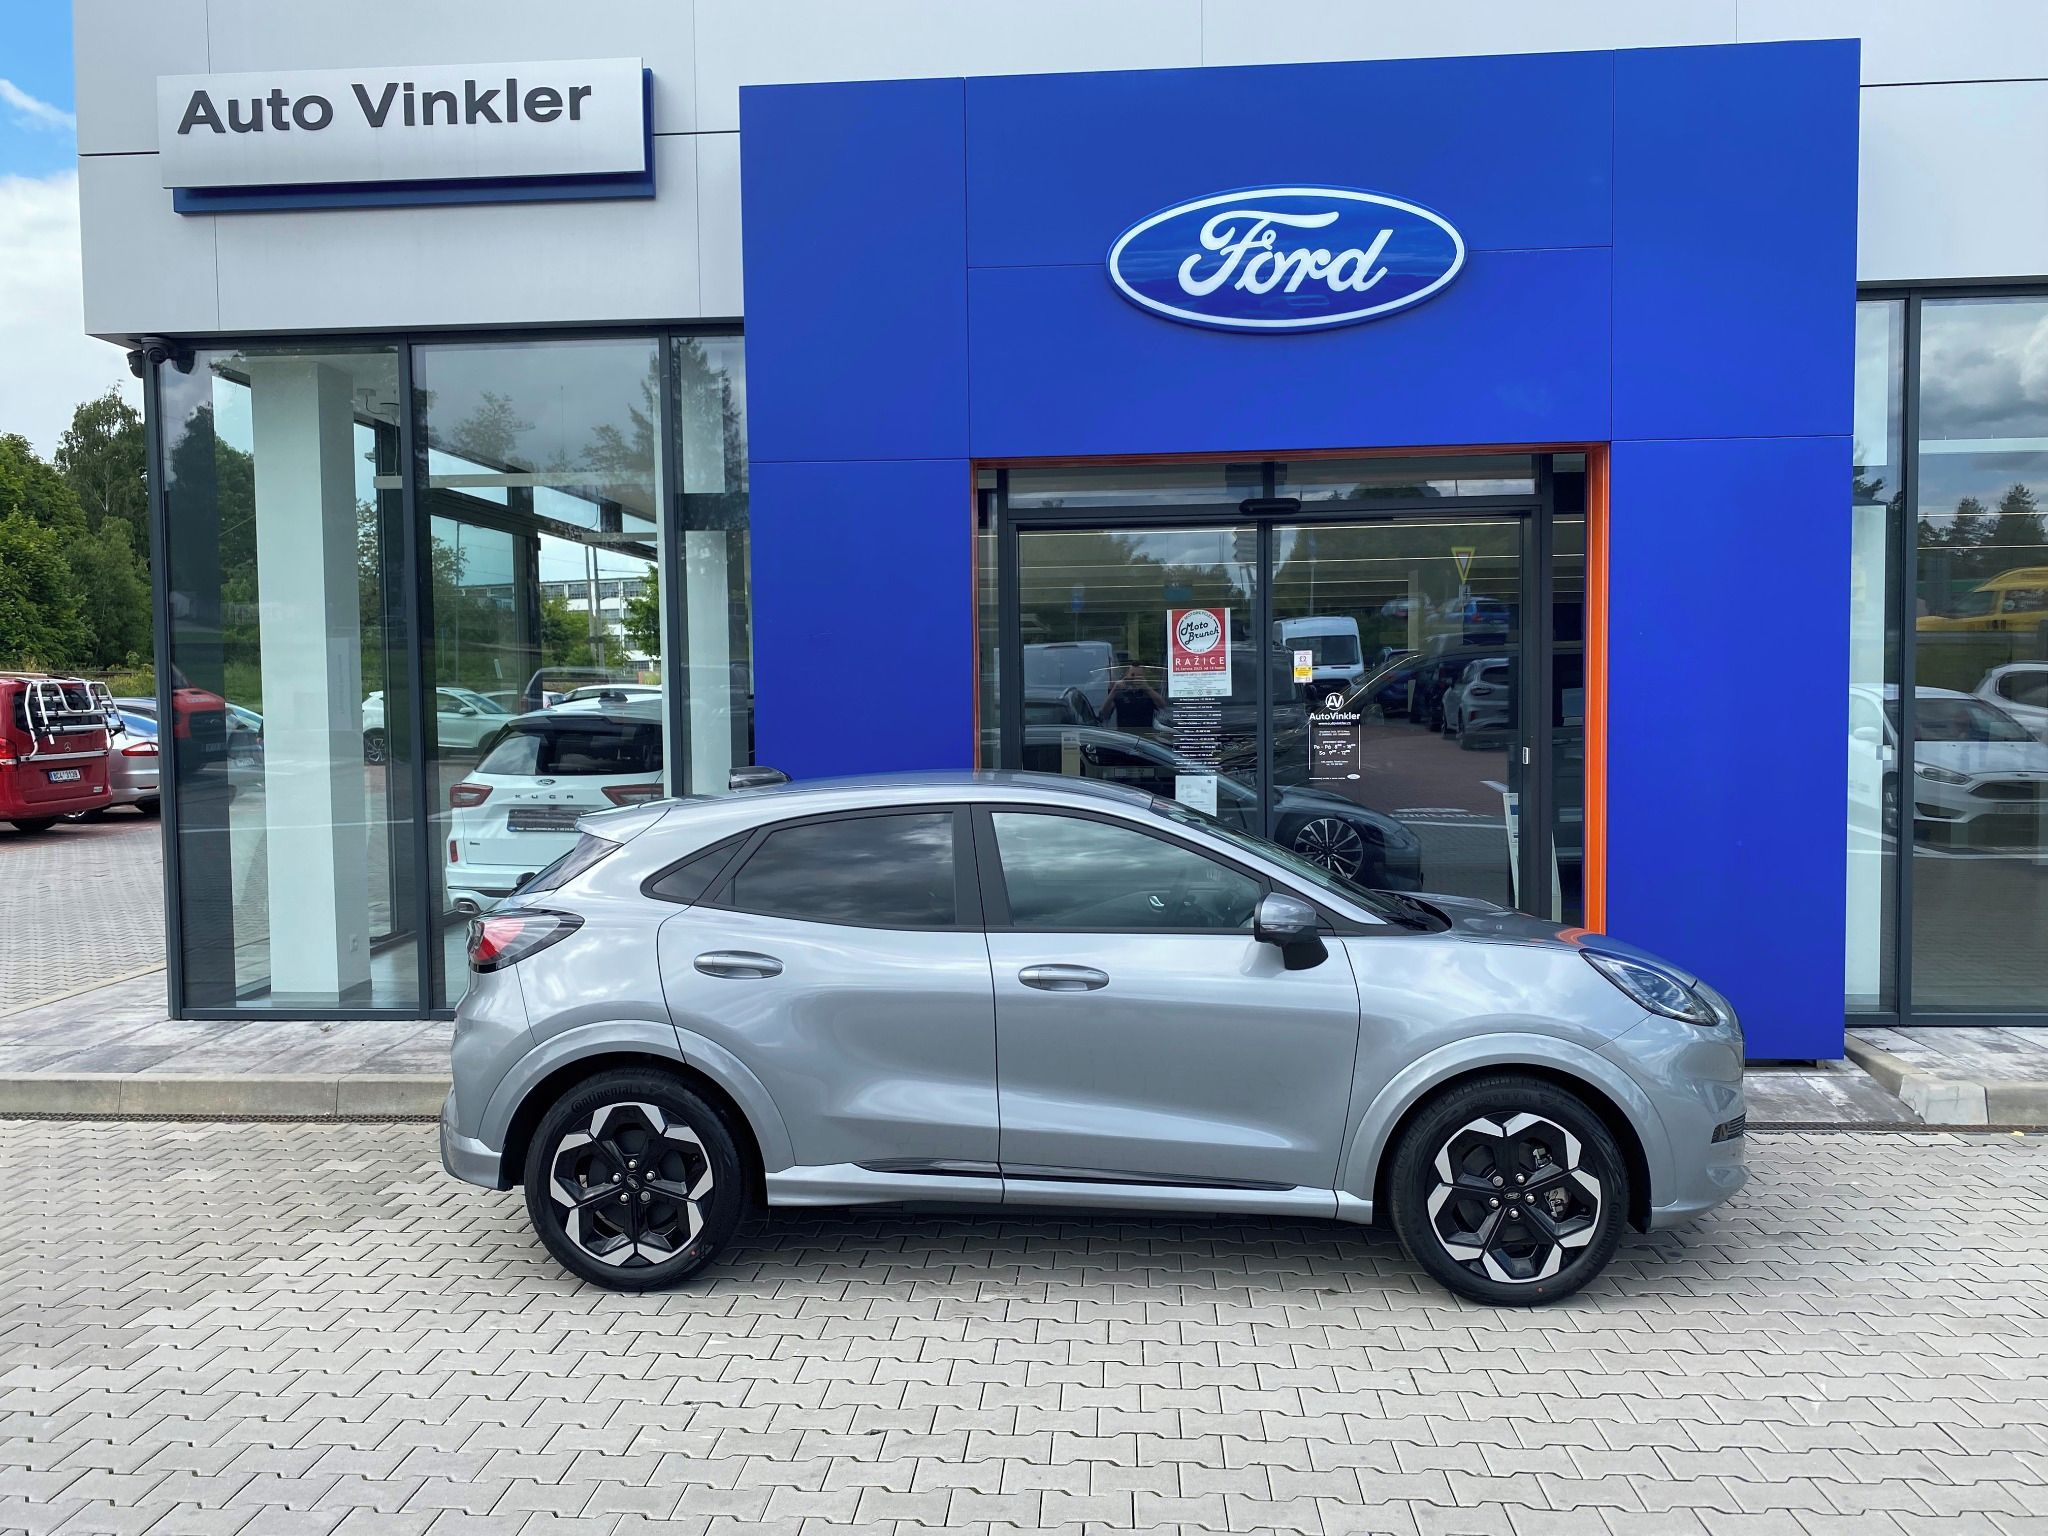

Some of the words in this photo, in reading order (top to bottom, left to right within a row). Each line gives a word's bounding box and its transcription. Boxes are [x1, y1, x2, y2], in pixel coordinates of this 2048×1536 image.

[177, 88, 334, 135] Auto
[350, 77, 592, 128] Vinkler
[1177, 210, 1394, 297] Ford
[1180, 621, 1209, 636] Moto
[1184, 628, 1220, 646] Brunch
[1175, 656, 1225, 666] RAŽICE
[1309, 712, 1360, 720] AutoVinkler
